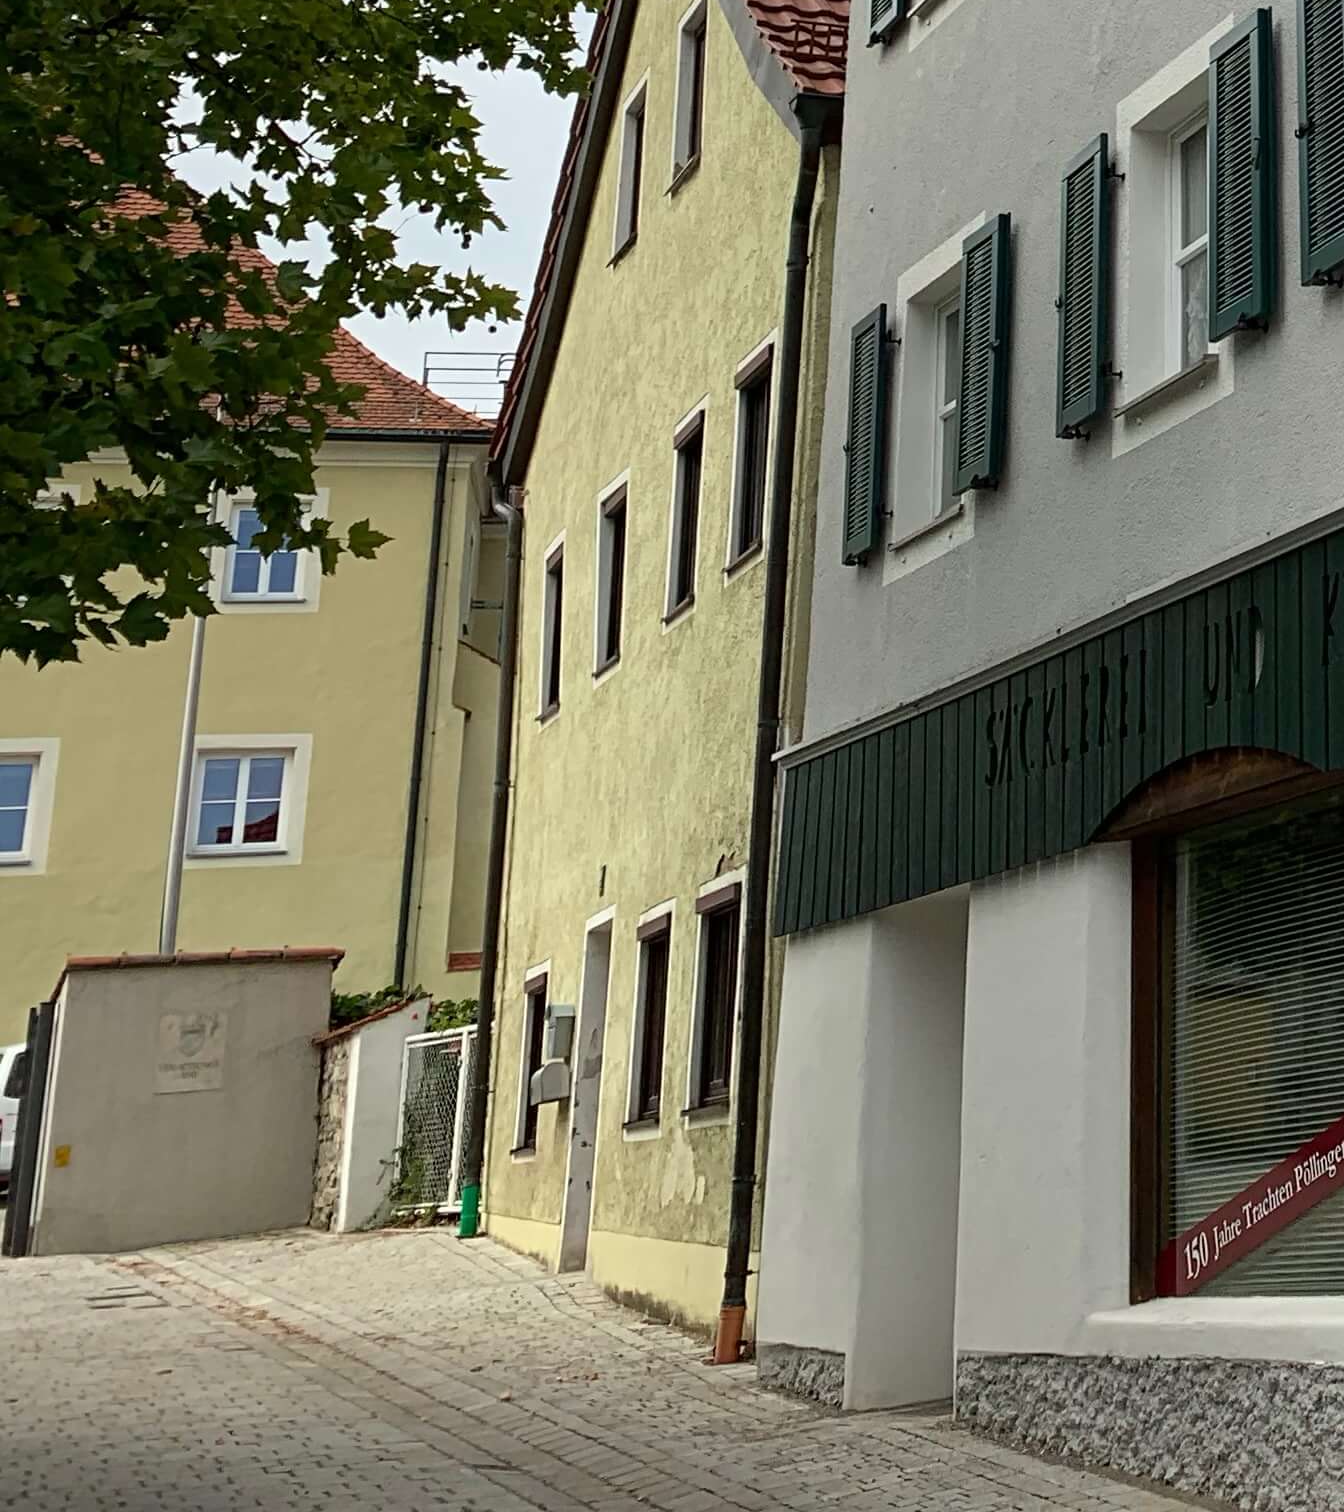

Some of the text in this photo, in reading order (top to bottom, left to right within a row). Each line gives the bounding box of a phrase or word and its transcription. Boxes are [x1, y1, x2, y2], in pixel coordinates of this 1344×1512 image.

[985, 649, 1147, 786] SÄCKLEREI
[1203, 606, 1265, 708] UND
[1184, 1232, 1209, 1279] 150
[1213, 1218, 1242, 1261] Jahre
[1241, 1180, 1294, 1229] Trachten
